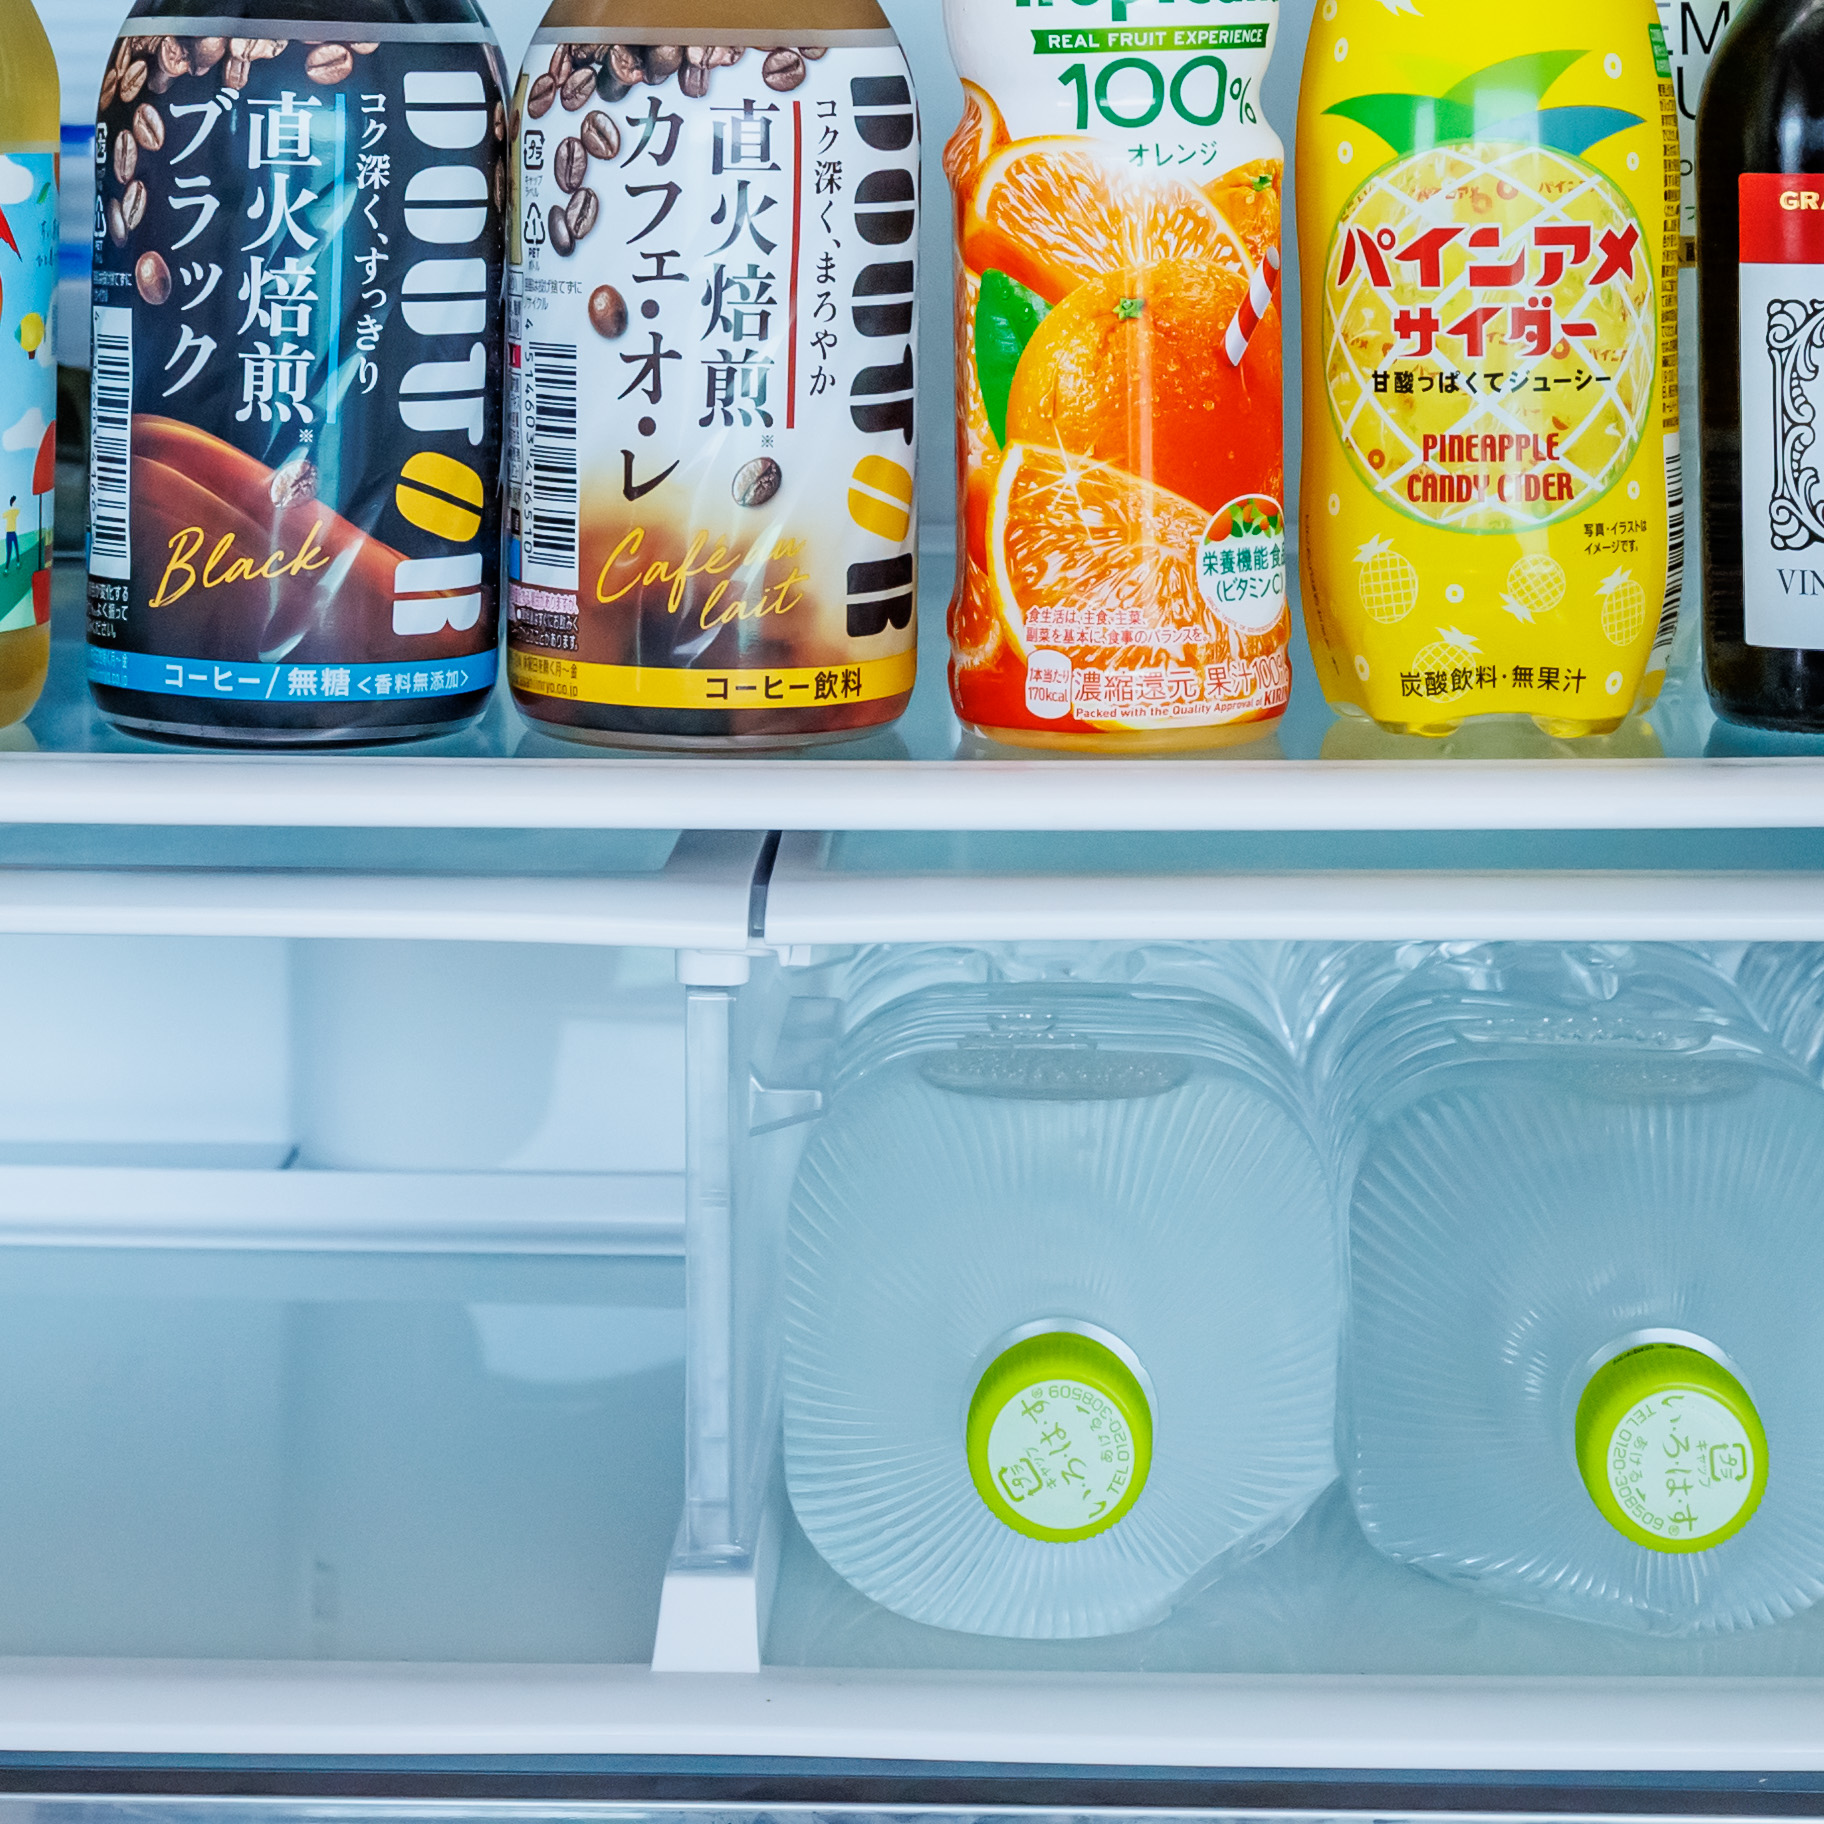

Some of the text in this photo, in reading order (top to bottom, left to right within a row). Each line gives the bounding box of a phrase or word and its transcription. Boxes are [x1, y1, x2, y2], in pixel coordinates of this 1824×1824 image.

[1048, 29, 1263, 48] REAL FRUIT EXPERIENCE
[1057, 55, 1257, 129] 100%
[527, 140, 542, 160] プラ
[1128, 141, 1217, 166] オレンジ
[161, 89, 237, 397] ブラック
[235, 96, 321, 422] 直火焙煎
[699, 99, 780, 428] 直火焙煎
[1337, 222, 1639, 287] パインアメ
[618, 96, 685, 503] カフェ・オ・レ
[1394, 296, 1597, 357] サイダー
[392, 70, 490, 636] DOUTOR
[846, 74, 917, 637] DOUTOR
[1372, 370, 1611, 393] 甘酸っぱくてジューシー
[1422, 432, 1560, 462] PINEAPPLE
[1407, 472, 1575, 503] CANDY CIDER
[148, 520, 329, 608] Black
[698, 573, 809, 632] lait
[705, 668, 863, 701] コーヒー飲料
[1029, 686, 1068, 703] 170kcal
[1075, 670, 1196, 703] 濃縮還元
[1077, 699, 1254, 718] Packed with the Quality Approval
[1400, 665, 1586, 696] 炭酸飲料・無果汁
[1049, 1385, 1130, 1494] TEL 0120-308509
[1627, 1405, 1657, 1426] TEL
[1613, 1429, 1664, 1531] 0120-308509
